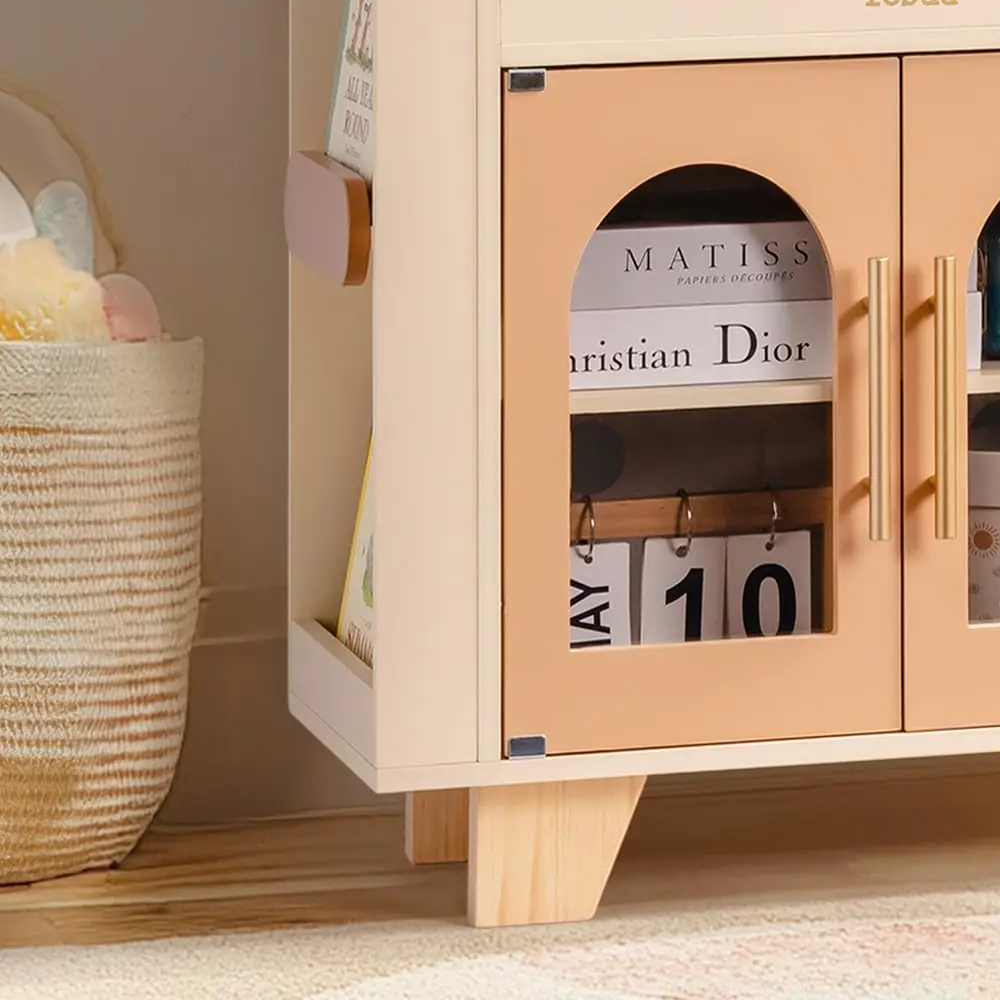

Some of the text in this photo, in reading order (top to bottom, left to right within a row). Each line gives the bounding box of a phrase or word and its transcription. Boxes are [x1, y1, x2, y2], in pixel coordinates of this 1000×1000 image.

[624, 239, 811, 273] MATISS
[677, 272, 727, 286] PAPIERS
[713, 323, 811, 366] Dior
